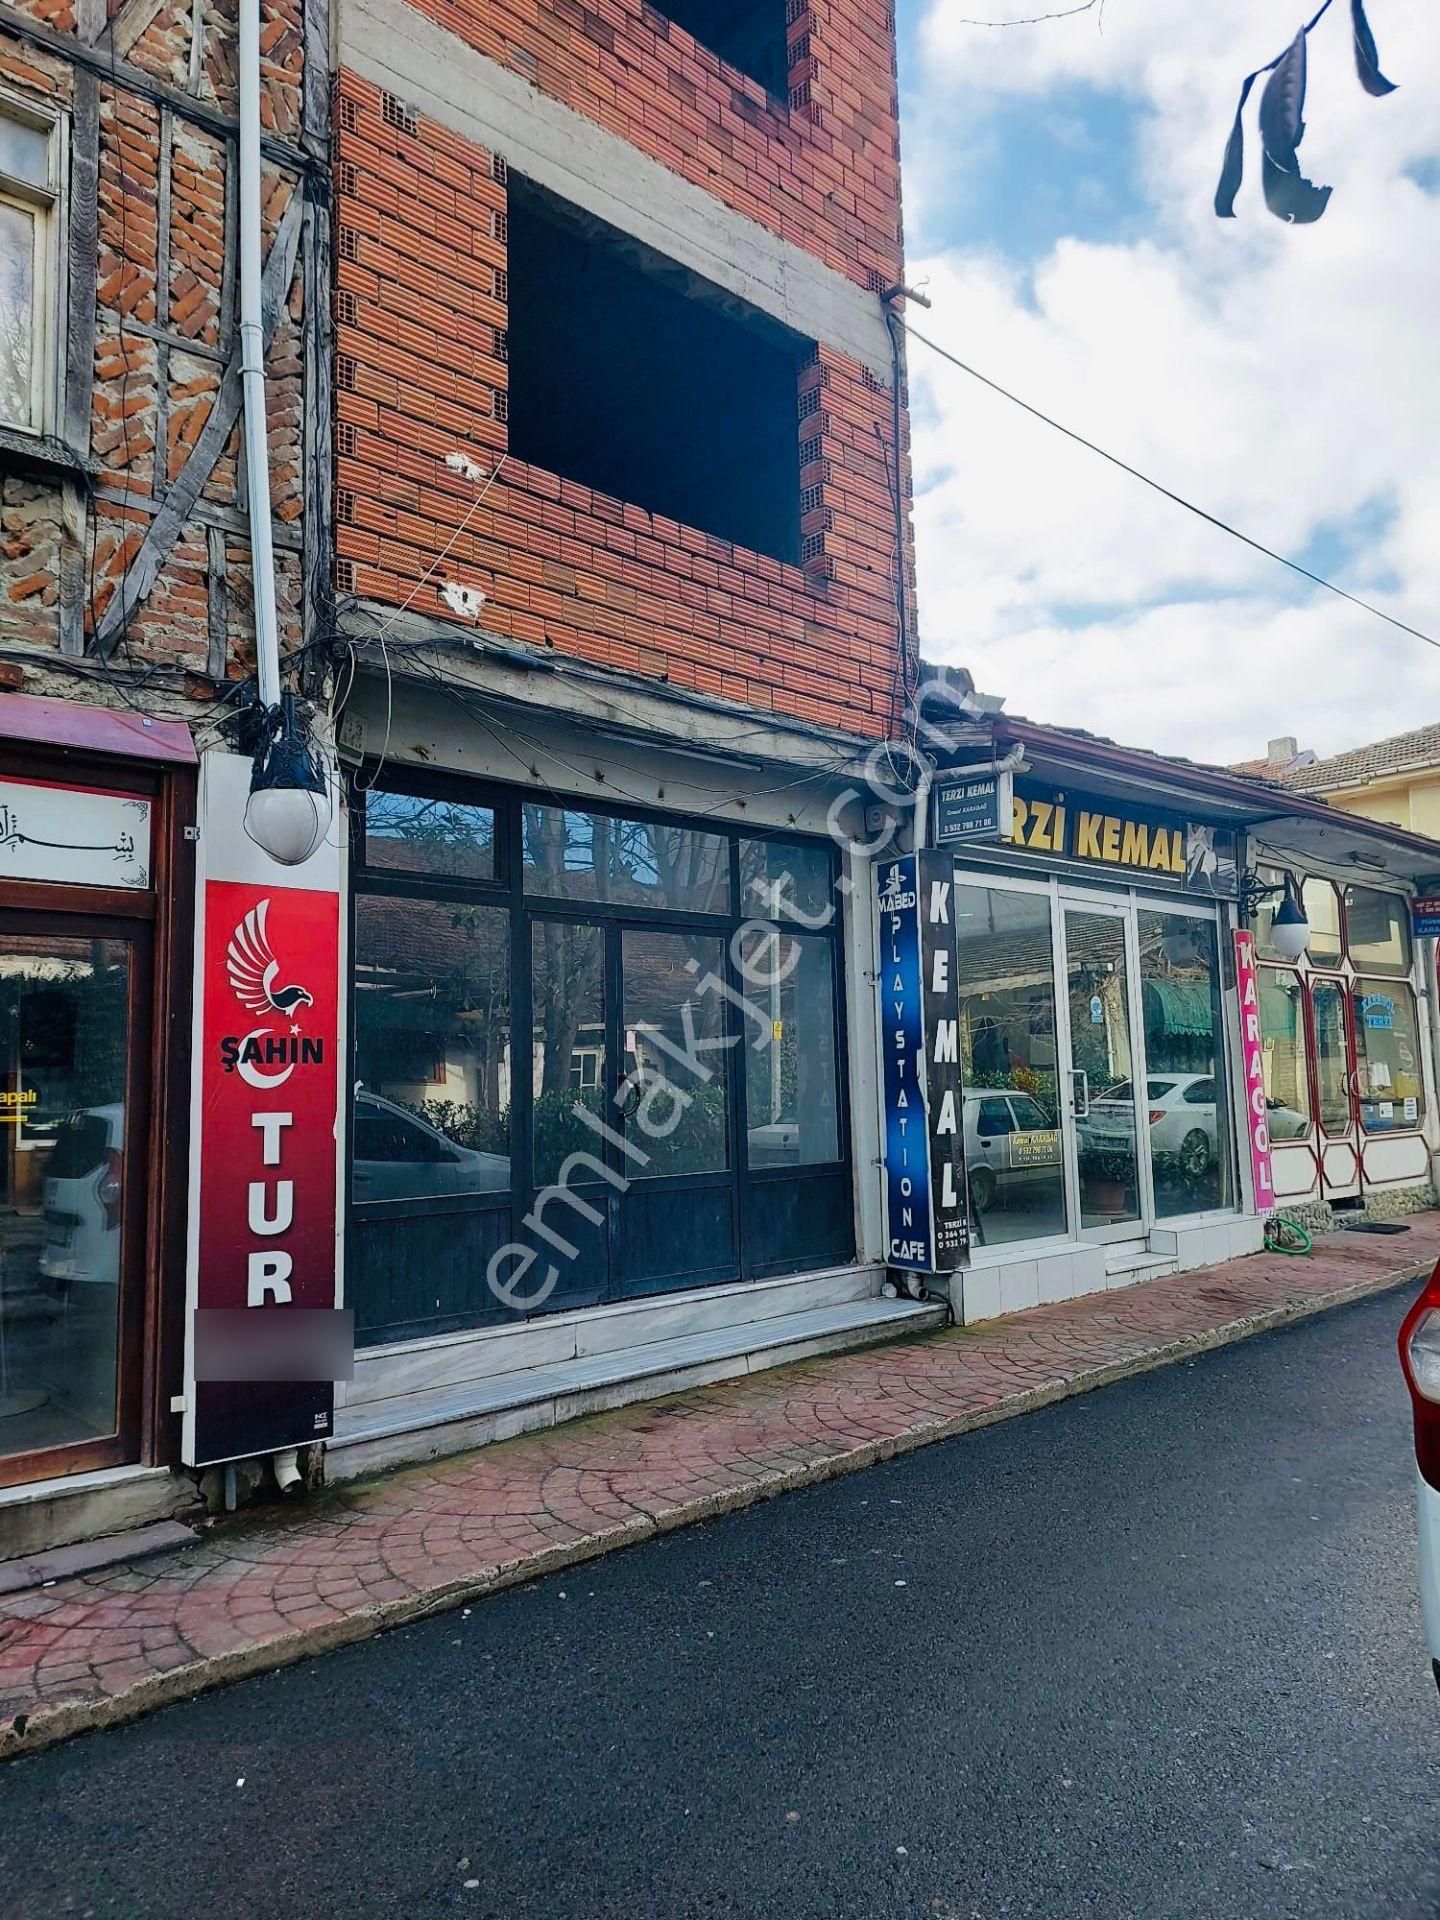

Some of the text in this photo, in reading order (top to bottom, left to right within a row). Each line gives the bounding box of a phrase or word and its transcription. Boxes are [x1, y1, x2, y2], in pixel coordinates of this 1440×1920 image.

[949, 823, 961, 832] 532
[967, 782, 995, 798] KEMAL
[1001, 792, 1187, 873] RZİ KEMAL
[892, 916, 912, 1228] PLAYSTATION
[929, 880, 958, 1208] KEMAL
[1239, 942, 1271, 1190] KARAGÖL
[247, 1112, 294, 1308] TUR
[891, 1239, 925, 1262] CAFE
[938, 1241, 944, 1249] 0
